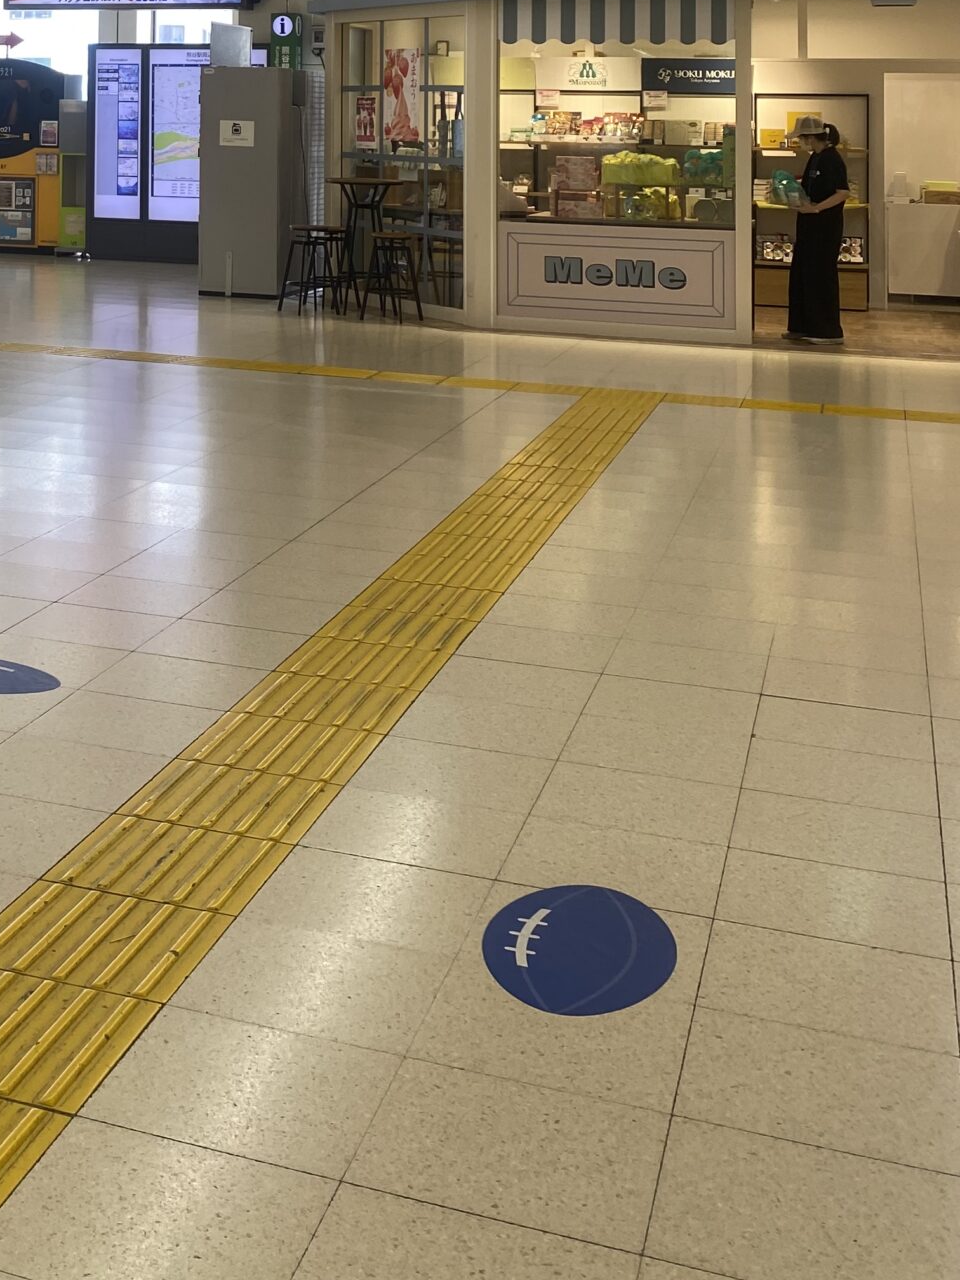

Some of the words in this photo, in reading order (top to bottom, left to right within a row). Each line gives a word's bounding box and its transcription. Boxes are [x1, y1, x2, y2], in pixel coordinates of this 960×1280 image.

[674, 70, 702, 78] YOKU
[705, 70, 735, 78] MOKU
[571, 78, 607, 87] Morozoff
[544, 255, 688, 291] MeMe
